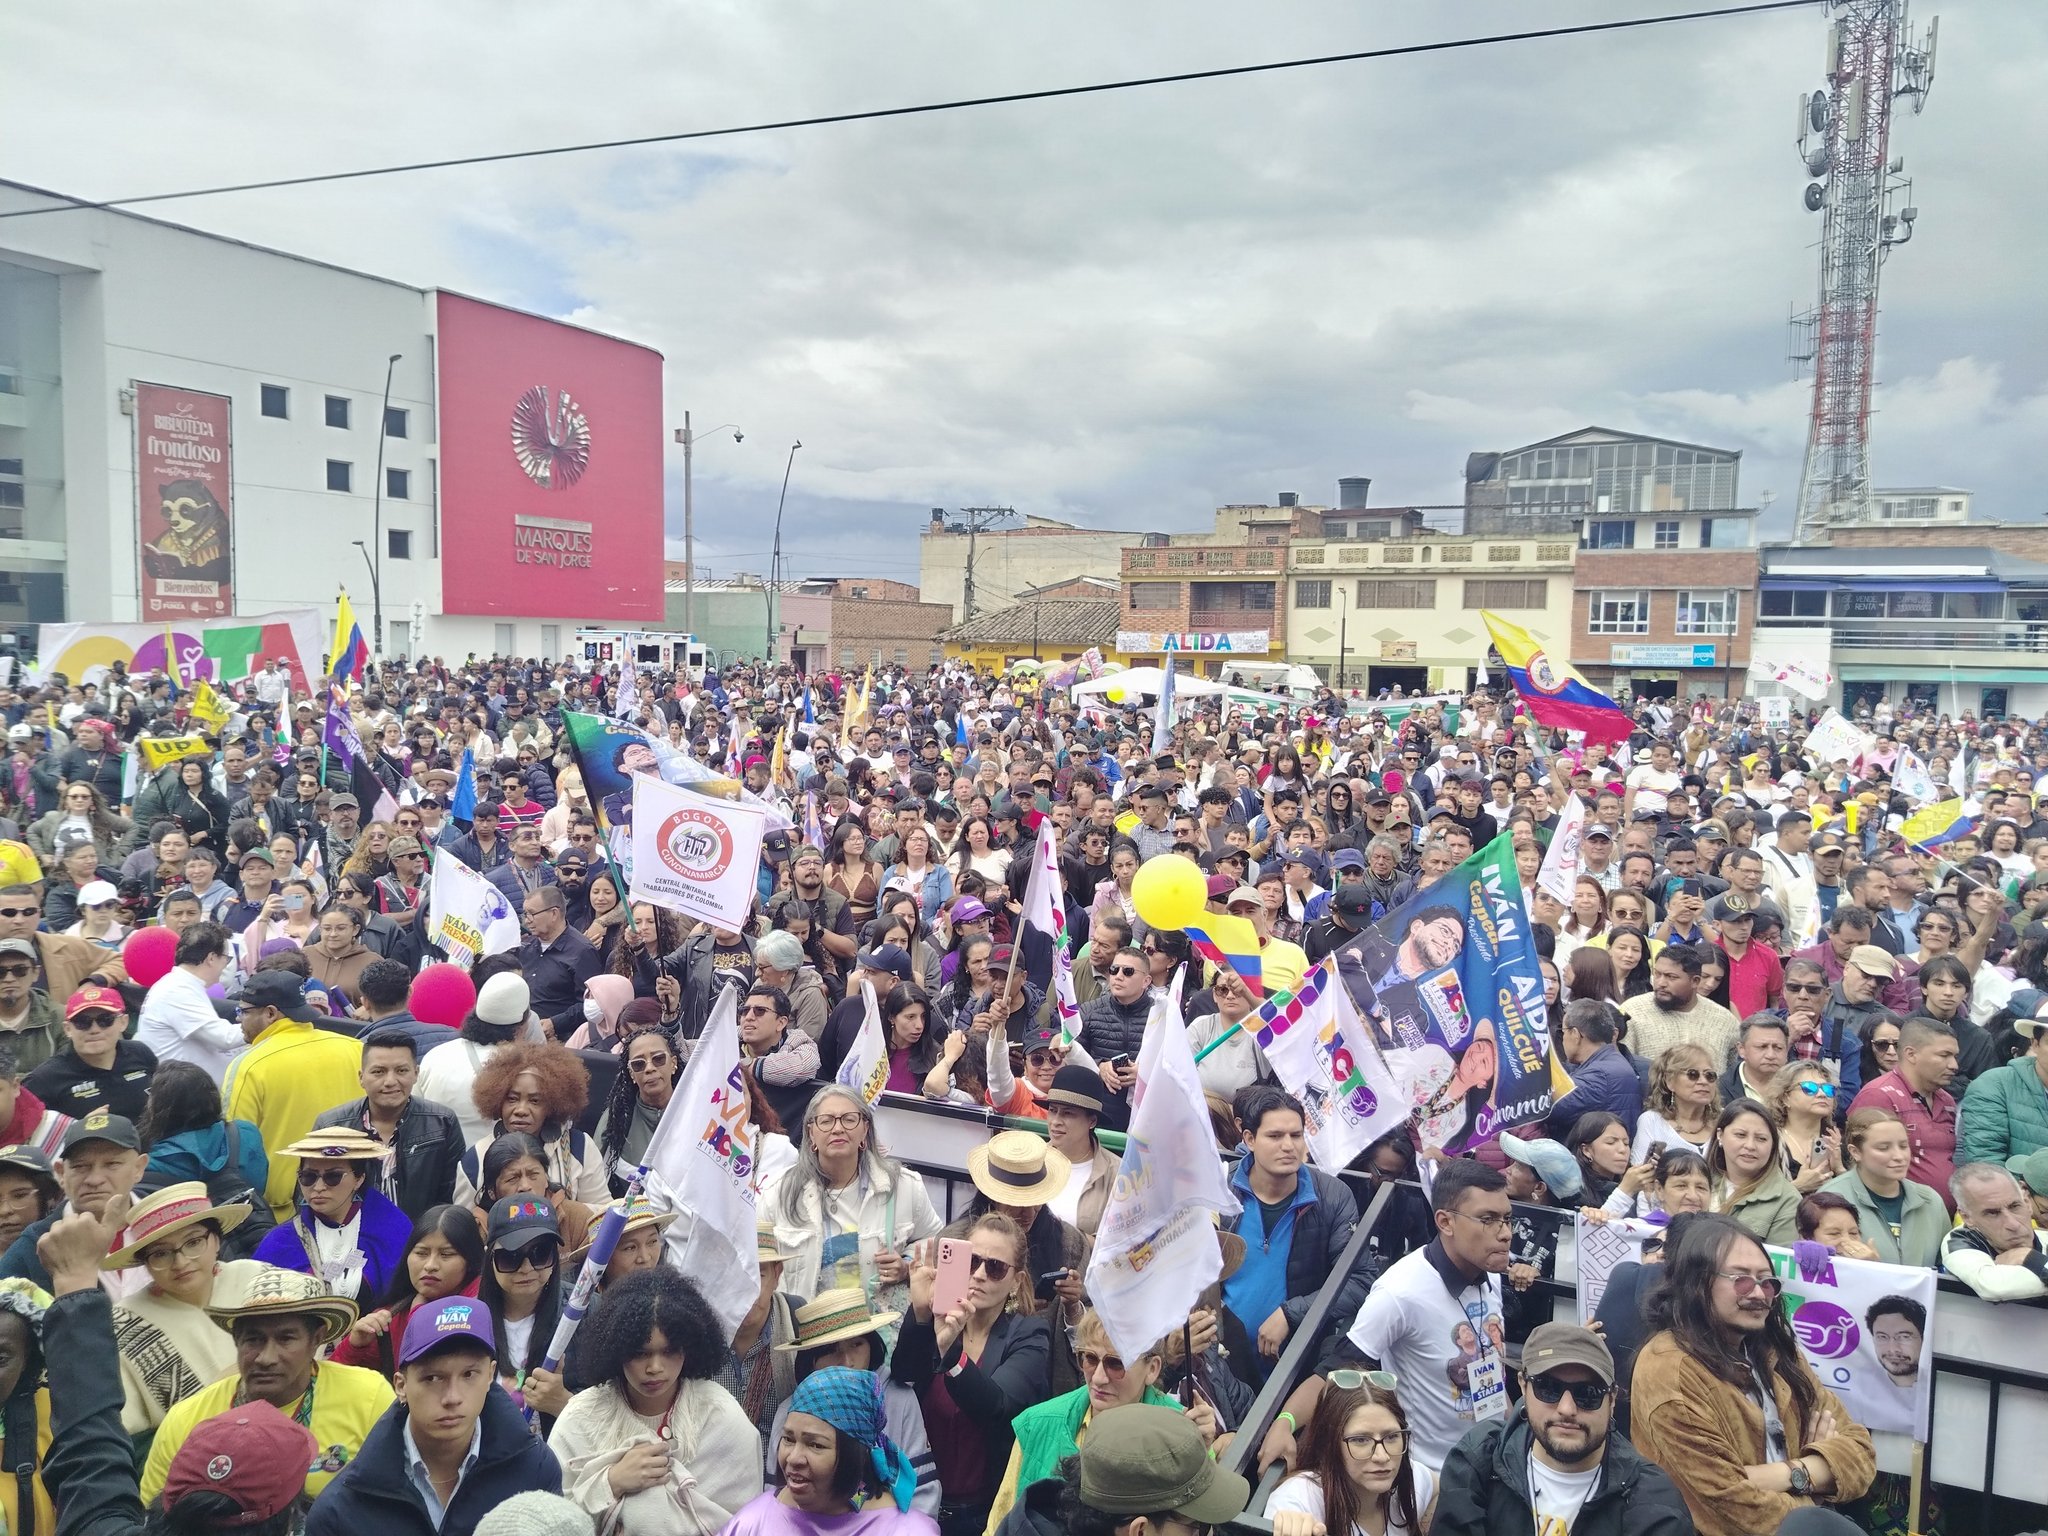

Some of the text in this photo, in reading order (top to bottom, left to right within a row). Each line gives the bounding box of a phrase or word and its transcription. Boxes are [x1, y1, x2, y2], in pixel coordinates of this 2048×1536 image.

[154, 414, 214, 437] BIBLIOTECA
[147, 435, 221, 464] frondoso
[514, 527, 592, 553] MARQUES
[516, 549, 592, 569] DE SAN JORGE
[163, 581, 213, 595] Bienvenidos
[1149, 632, 1232, 651] SALIDA
[152, 741, 192, 754] UP
[661, 848, 727, 880] CUNDINAMARCA
[643, 882, 724, 911] TRABAJADORES DE COLOMBIA
[654, 877, 716, 901] CENTRAL UNITARIA DE
[1402, 1014, 1426, 1049] NATALIA
[1497, 987, 1544, 1075] QUILCUÉ
[702, 1118, 752, 1178] PACTO
[437, 1322, 471, 1332] Cepeda
[1473, 1362, 1495, 1378] IVAN
[1477, 1384, 1499, 1400] STAFF
